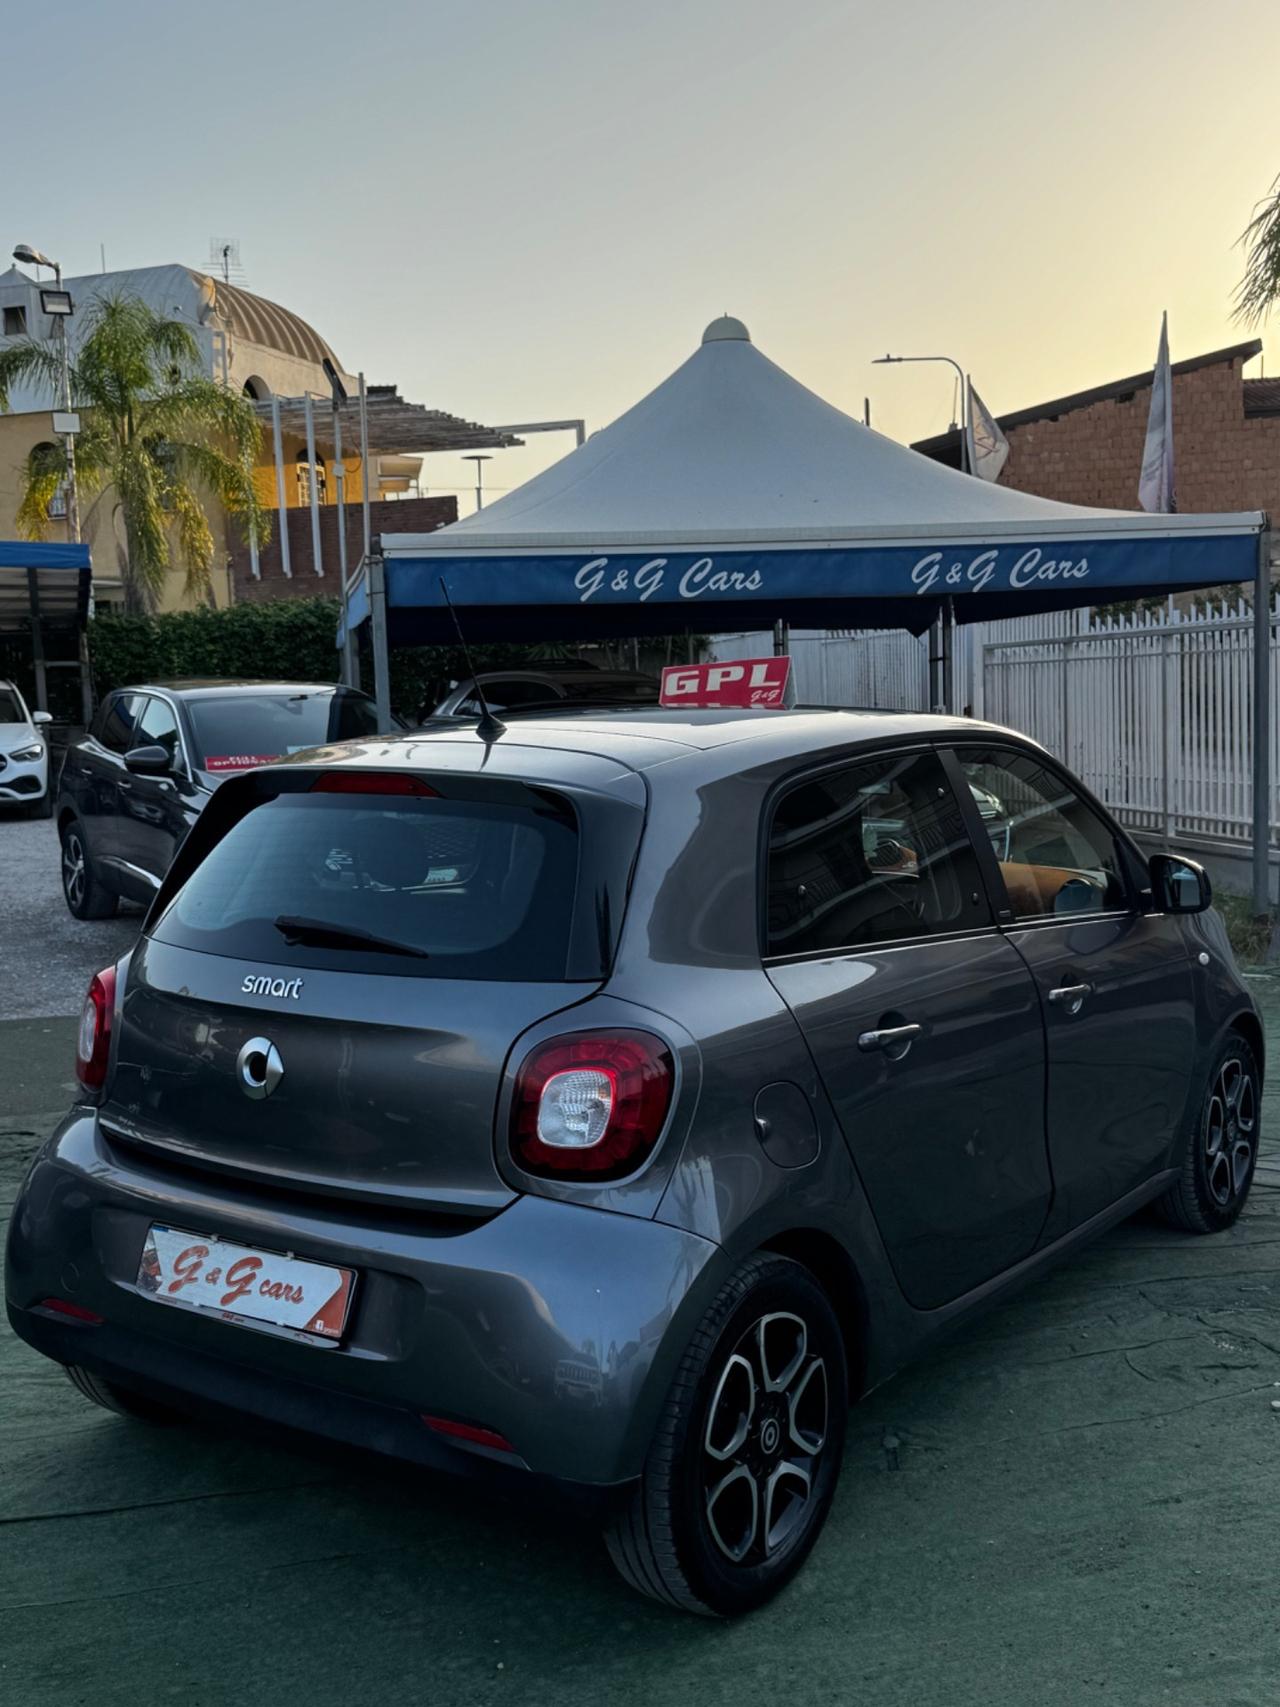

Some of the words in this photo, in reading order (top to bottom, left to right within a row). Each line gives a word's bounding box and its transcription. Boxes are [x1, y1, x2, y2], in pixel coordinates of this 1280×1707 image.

[679, 557, 764, 598] Cars
[1009, 547, 1090, 589] Cars
[664, 664, 781, 696] GPL
[241, 974, 303, 999] smart
[259, 1279, 304, 1304] cars
